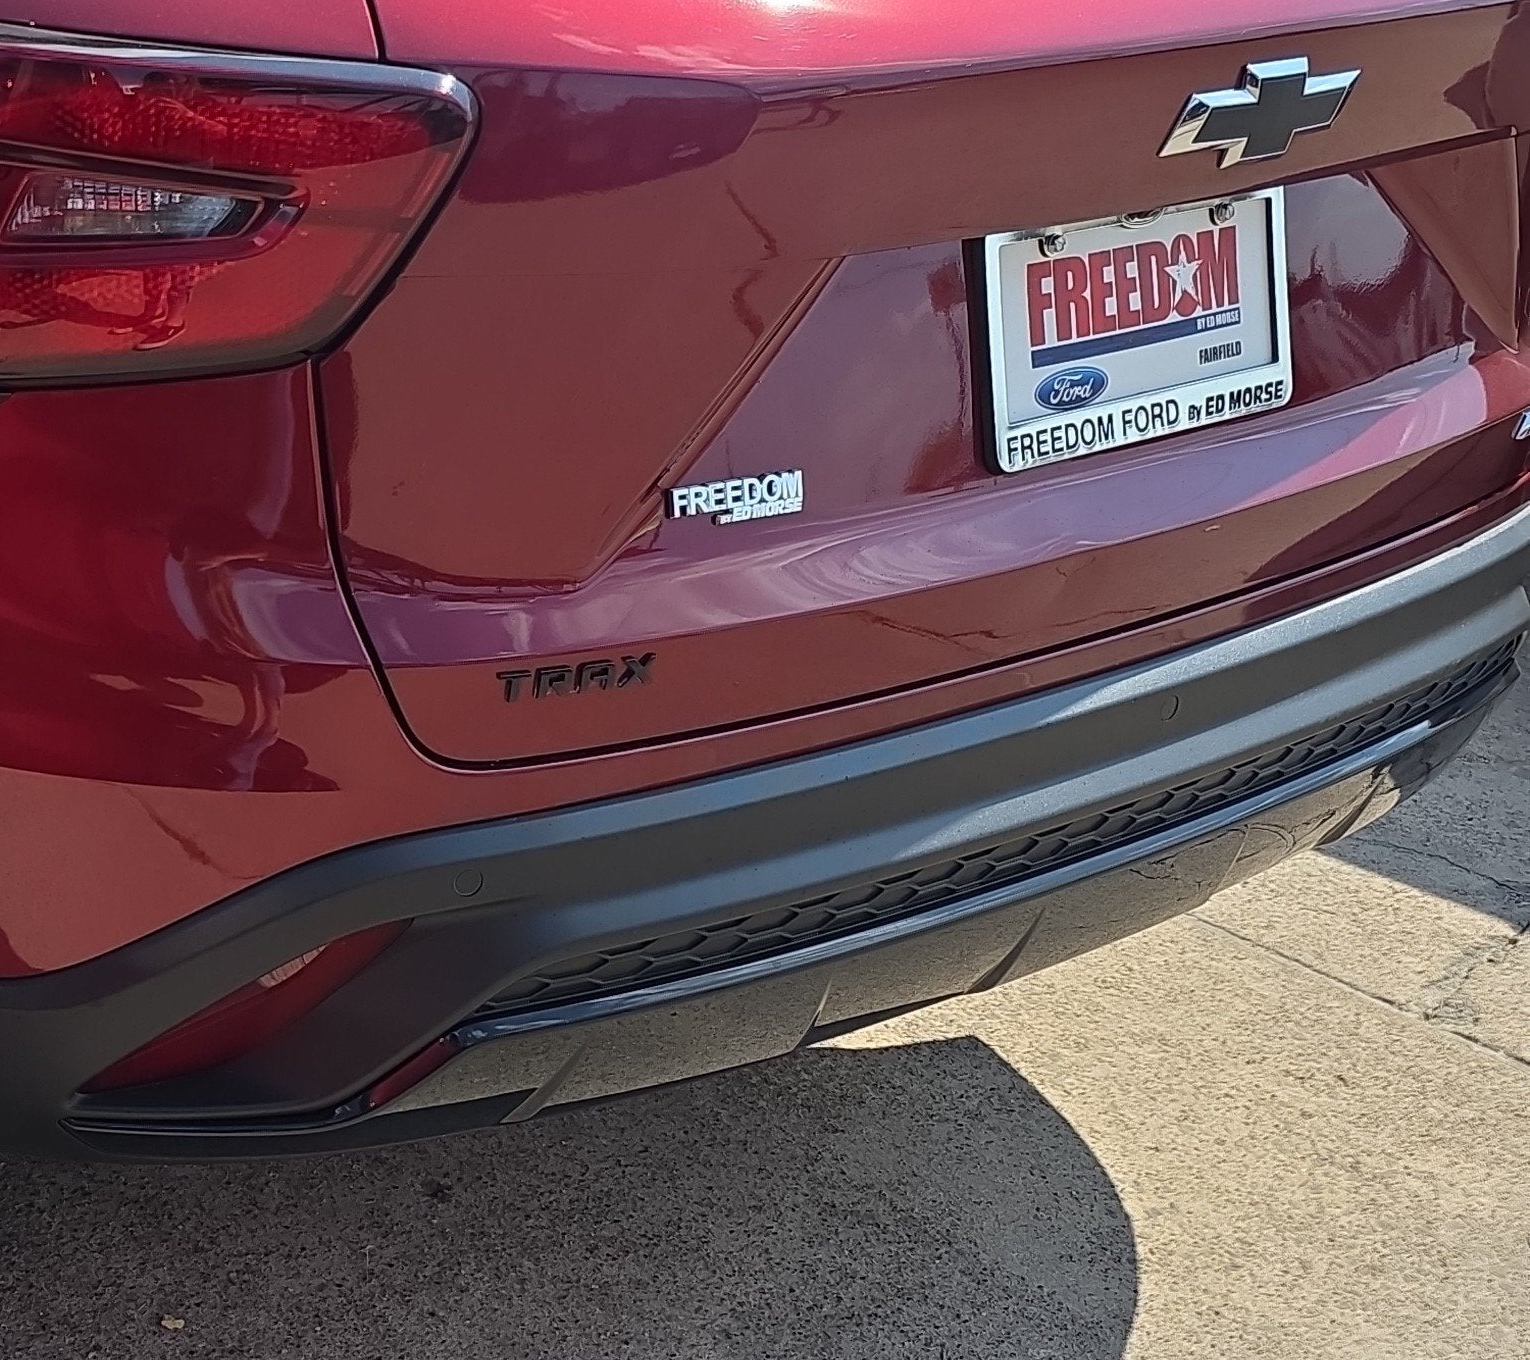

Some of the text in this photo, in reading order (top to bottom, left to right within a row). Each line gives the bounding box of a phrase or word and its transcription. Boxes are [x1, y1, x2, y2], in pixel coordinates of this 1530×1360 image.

[1026, 226, 1240, 347] FREEDOM
[1197, 310, 1239, 330] BY ED MORSE
[1199, 341, 1242, 365] FAIRFIELD
[1050, 373, 1094, 404] Ford
[1007, 414, 1115, 465] FREEDOM
[1122, 399, 1179, 437] FORD
[1205, 394, 1225, 417] ED
[1229, 380, 1284, 411] MORSE
[669, 470, 803, 519] FREEDOM
[732, 505, 751, 522] ED
[752, 497, 803, 518] MORSE
[496, 652, 656, 703] TRAX
